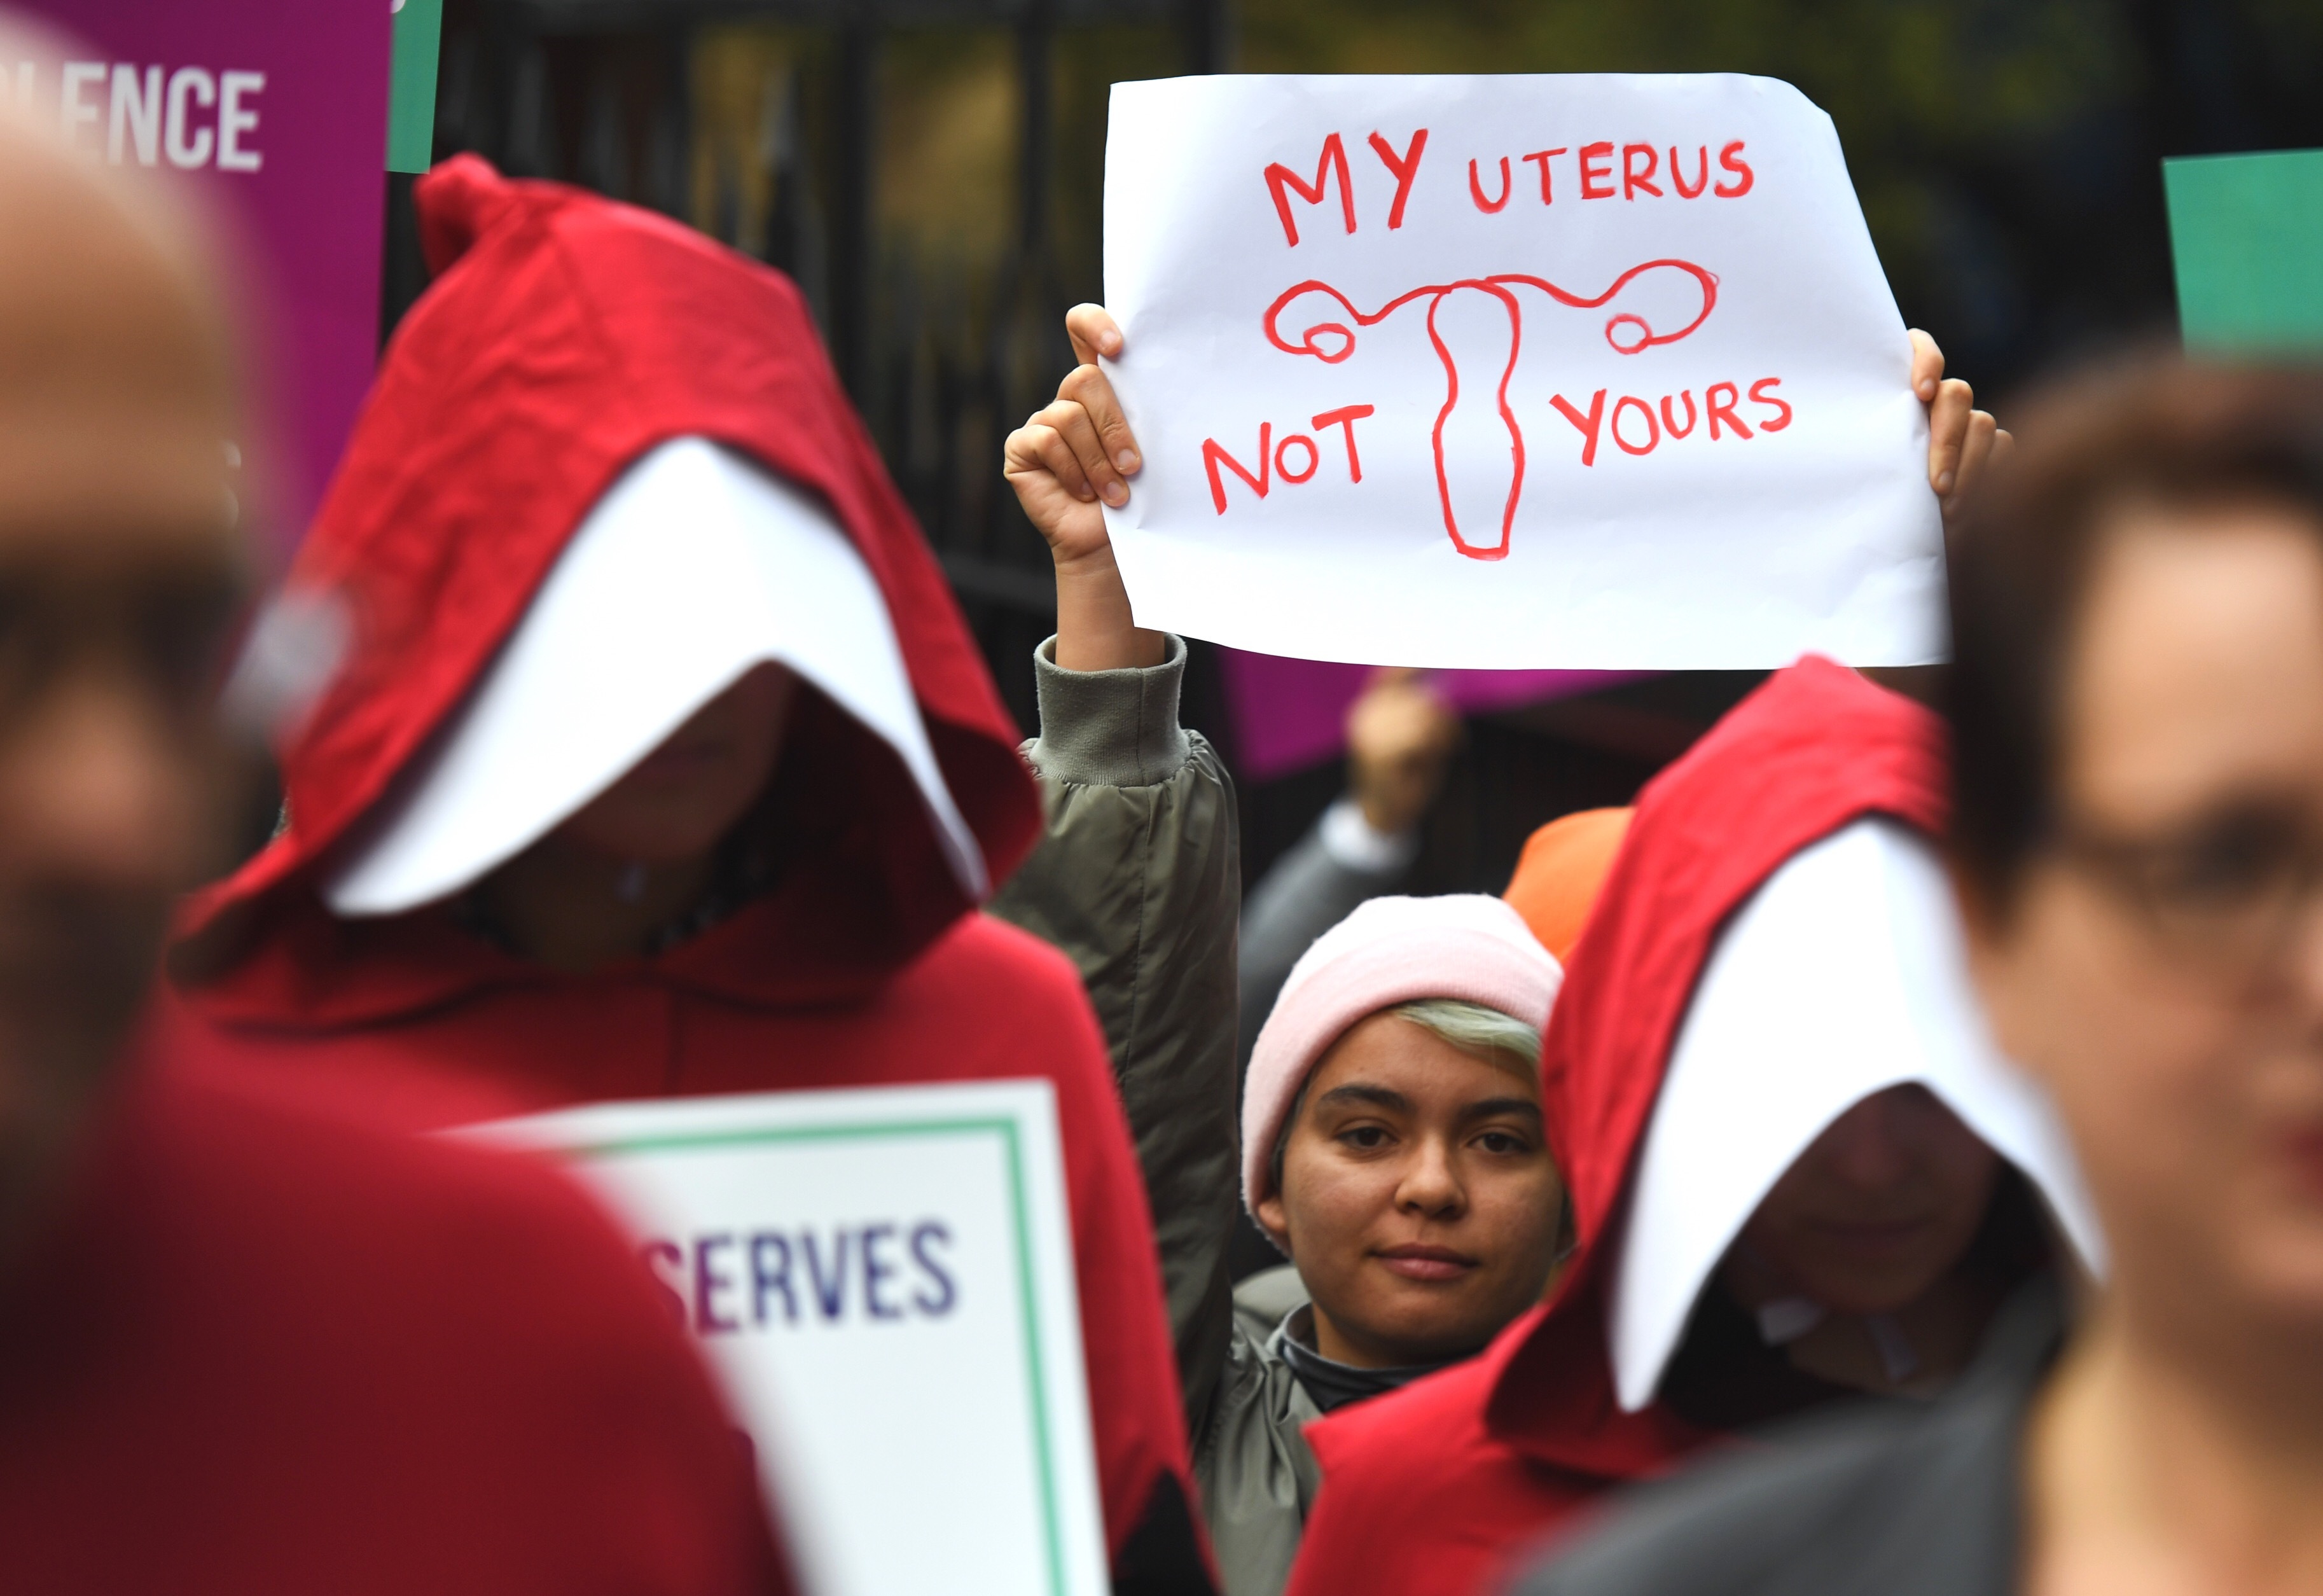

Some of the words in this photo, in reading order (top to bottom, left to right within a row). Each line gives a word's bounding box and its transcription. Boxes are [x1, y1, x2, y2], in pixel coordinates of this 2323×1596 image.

[1263, 128, 1429, 248] MY
[1469, 140, 1754, 214] UTERUS
[1202, 404, 1375, 516] NOT
[1549, 377, 1793, 468] YOURS
